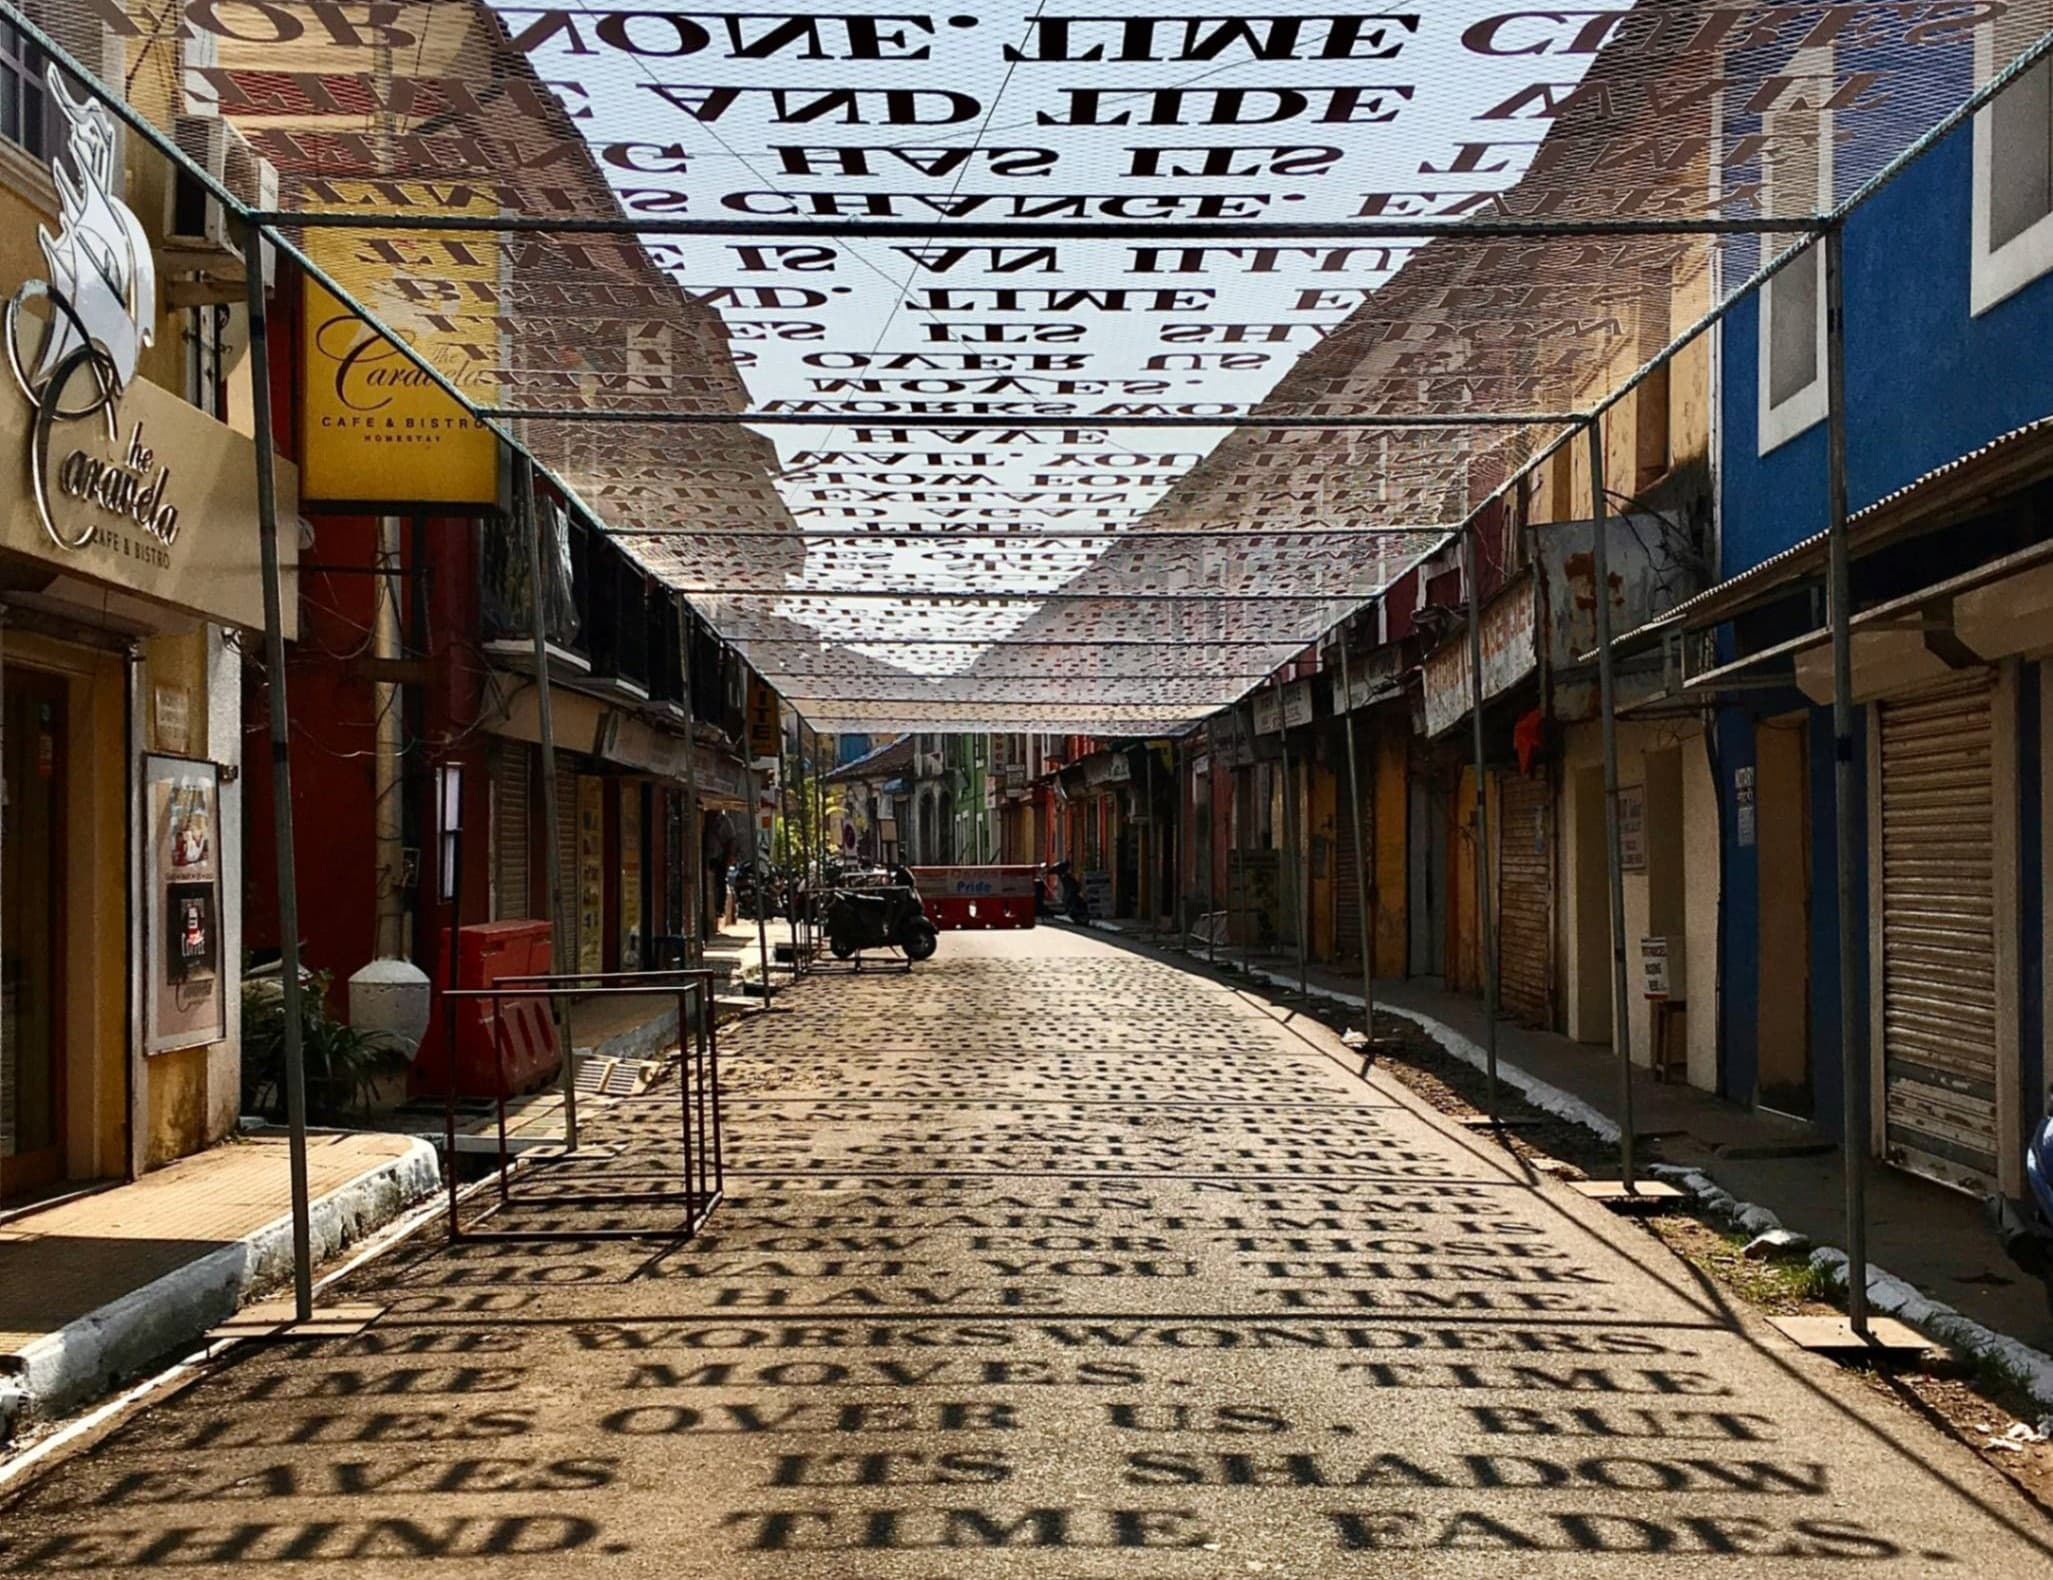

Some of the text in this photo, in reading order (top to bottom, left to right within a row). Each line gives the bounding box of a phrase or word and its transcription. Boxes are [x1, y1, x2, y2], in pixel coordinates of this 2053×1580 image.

[316, 314, 483, 411] Caraela
[322, 416, 487, 430] CAFE & BISTRO
[363, 434, 442, 443] HOMESTAY
[93, 527, 171, 570] CAFE & BISTRO
[956, 880, 993, 893] Pride
[934, 1157, 1476, 1178] EVERYTHING.
[750, 1179, 993, 1191] TIME
[1067, 1179, 1142, 1191] IS
[1192, 1180, 1492, 1198] NEVER
[834, 1195, 1514, 1216] AGAIN. TIME
[1452, 1218, 1546, 1234] IS
[630, 1236, 927, 1254] SLOW
[967, 1236, 1176, 1253] FOR
[1212, 1236, 1569, 1260] THOSE
[633, 1260, 948, 1279] WAIT.
[975, 1259, 1199, 1278] YOU
[1239, 1261, 1612, 1285] THINK
[706, 1287, 1064, 1309] HAVE
[1249, 1289, 1619, 1313] TIME.
[562, 1326, 1014, 1350] WORKS
[1040, 1325, 1699, 1358] WONDERS.
[608, 1361, 1194, 1389] MOVES.
[1337, 1363, 1736, 1398] TIME
[598, 1402, 1022, 1435] OVER
[1100, 1402, 1357, 1435] US.
[1457, 1405, 1780, 1442] BUT
[753, 1453, 1013, 1487] ITS
[1122, 1452, 1828, 1495] SHADOW
[720, 1507, 1212, 1554] TIME
[1322, 1511, 1958, 1561] FADES.
